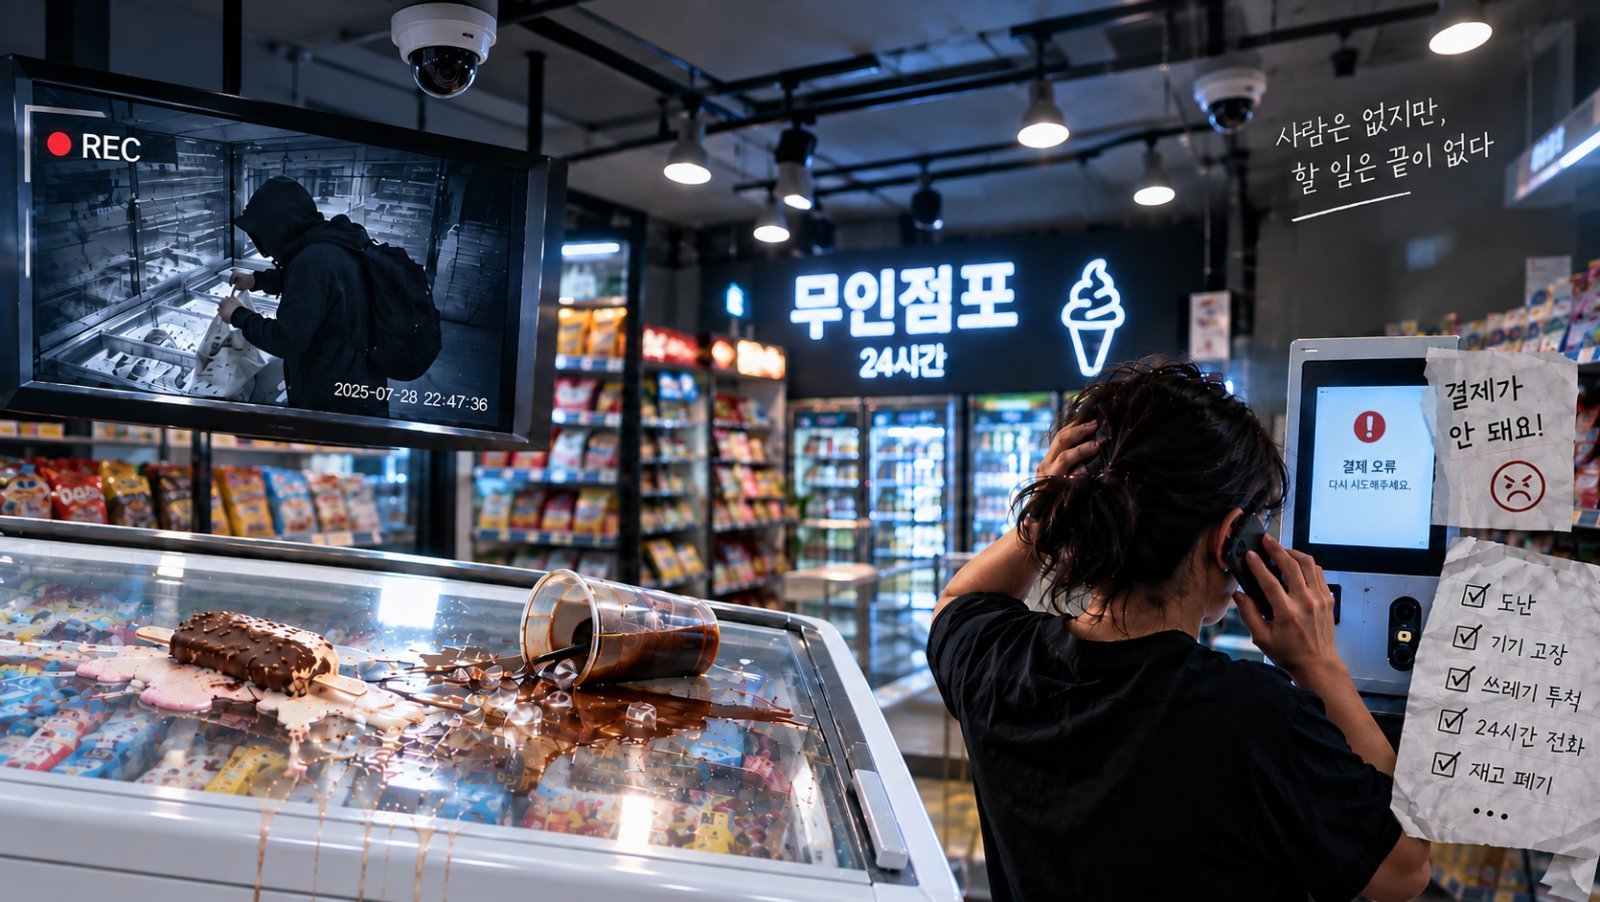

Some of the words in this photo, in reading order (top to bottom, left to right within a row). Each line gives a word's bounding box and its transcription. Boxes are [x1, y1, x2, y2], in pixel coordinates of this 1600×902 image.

[81, 133, 141, 163] REC
[790, 261, 1019, 341] 무인점포
[859, 343, 948, 379] 24시간
[334, 381, 418, 404] 2025-07-28
[423, 391, 488, 412] 22:47:36
[1445, 374, 1524, 411] 결제가
[1449, 420, 1476, 450] 안
[1486, 412, 1544, 443] 돼요!
[1343, 459, 1368, 474] 결제
[1371, 460, 1397, 474] 오류
[1328, 479, 1348, 490] 다시
[1350, 479, 1411, 491] 시도해주세요.
[1497, 593, 1537, 616] 도난
[1491, 635, 1524, 657] 기기
[1530, 643, 1568, 666] 고장
[1481, 675, 1538, 703] 쓰레기
[1545, 685, 1582, 713] 투척
[1475, 719, 1538, 748] 24시간
[1546, 731, 1585, 757] 전화
[1468, 762, 1505, 785] 재고
[1512, 771, 1553, 796] 폐기
